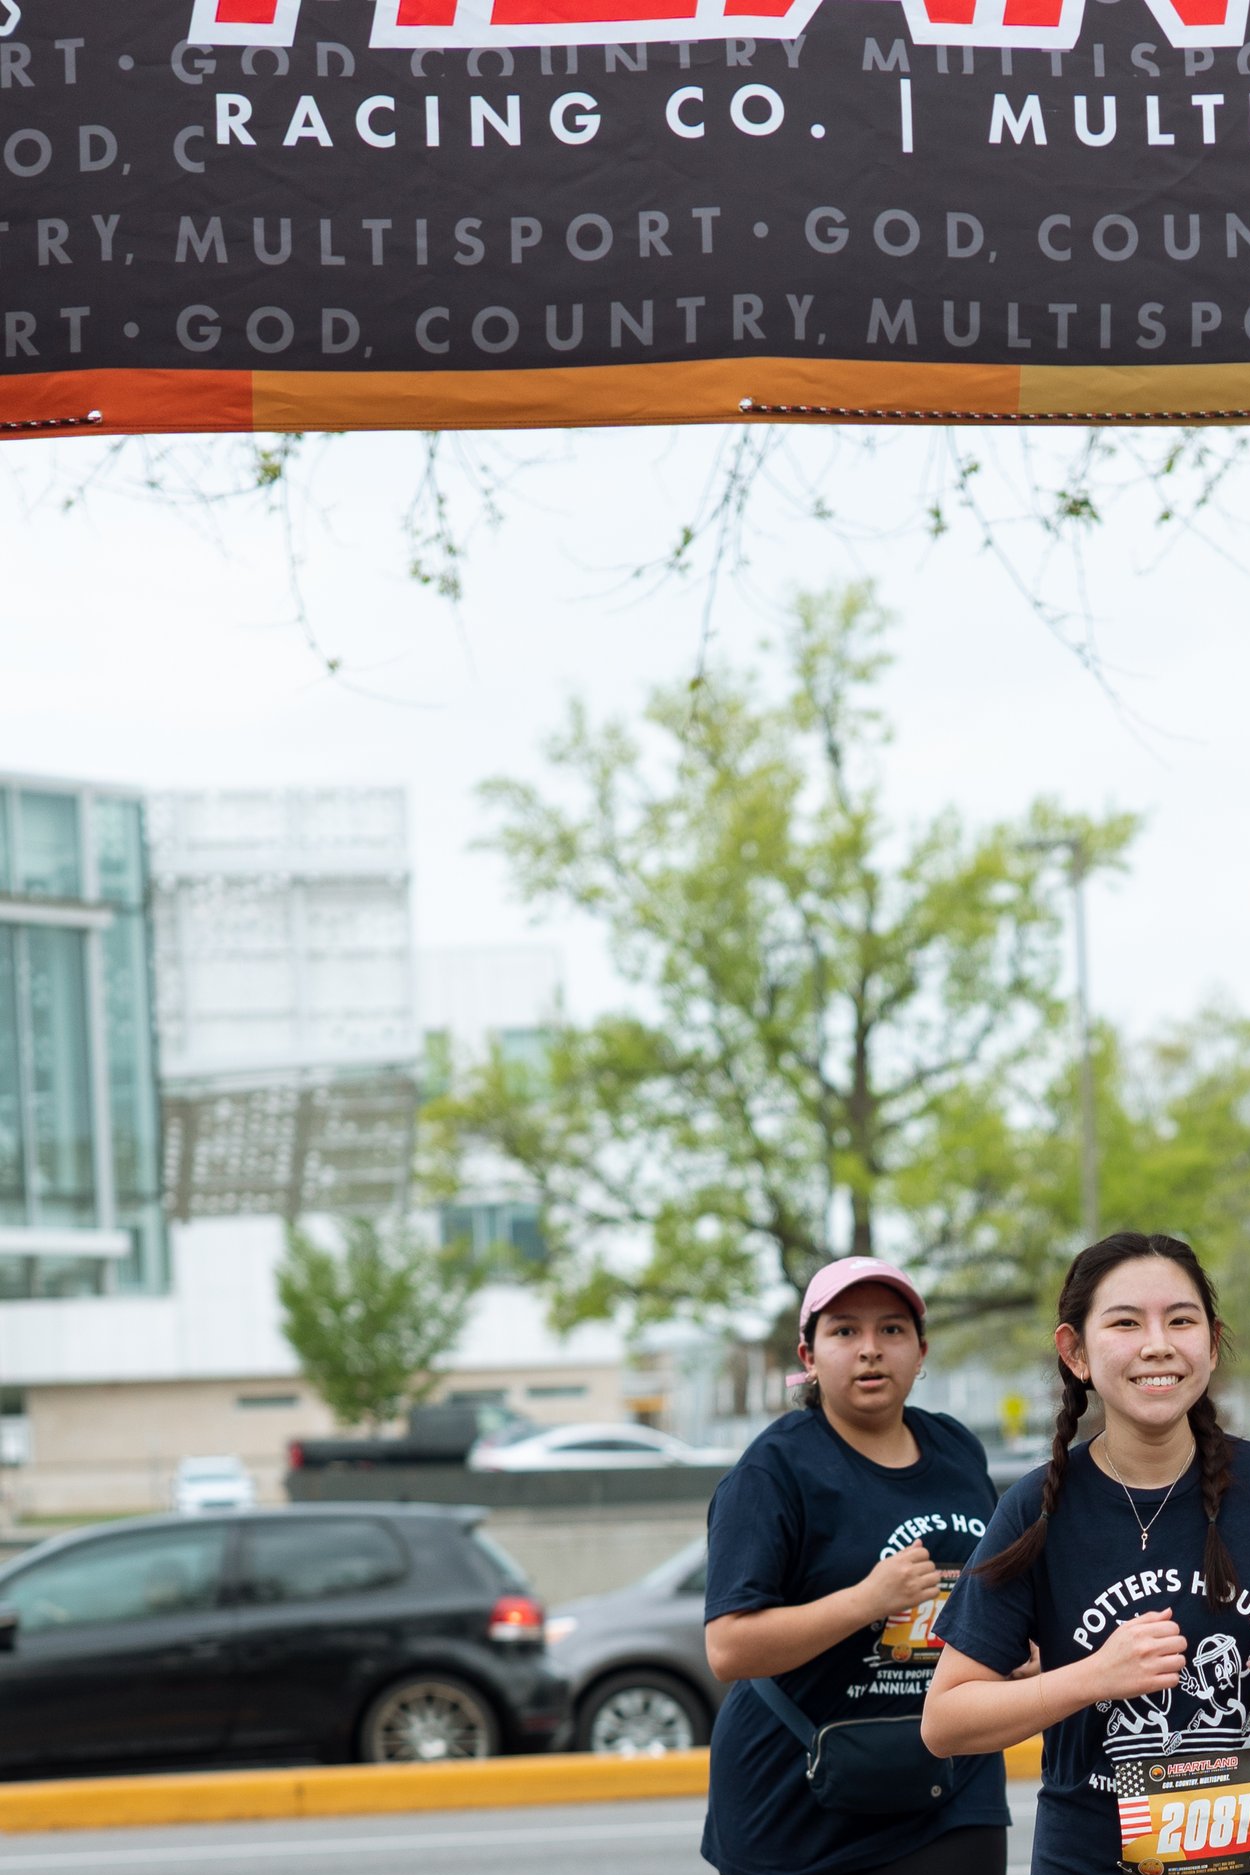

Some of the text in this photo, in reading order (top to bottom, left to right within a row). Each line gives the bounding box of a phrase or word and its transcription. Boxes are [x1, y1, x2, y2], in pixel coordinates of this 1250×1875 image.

[216, 92, 601, 148] RACING
[666, 84, 826, 138] CO.
[0, 214, 134, 265] RY,
[176, 207, 721, 265] MULTISPORT
[805, 206, 996, 262] GOD,
[176, 304, 373, 357] GOD,
[416, 293, 827, 354] COUNTRY,
[880, 1514, 947, 1560] OTTER'S
[1073, 1569, 1181, 1650] POTTER'S
[868, 1680, 922, 1695] ANNUAL
[877, 1669, 904, 1679] STEVE
[1167, 1756, 1239, 1775] HEARTLAND
